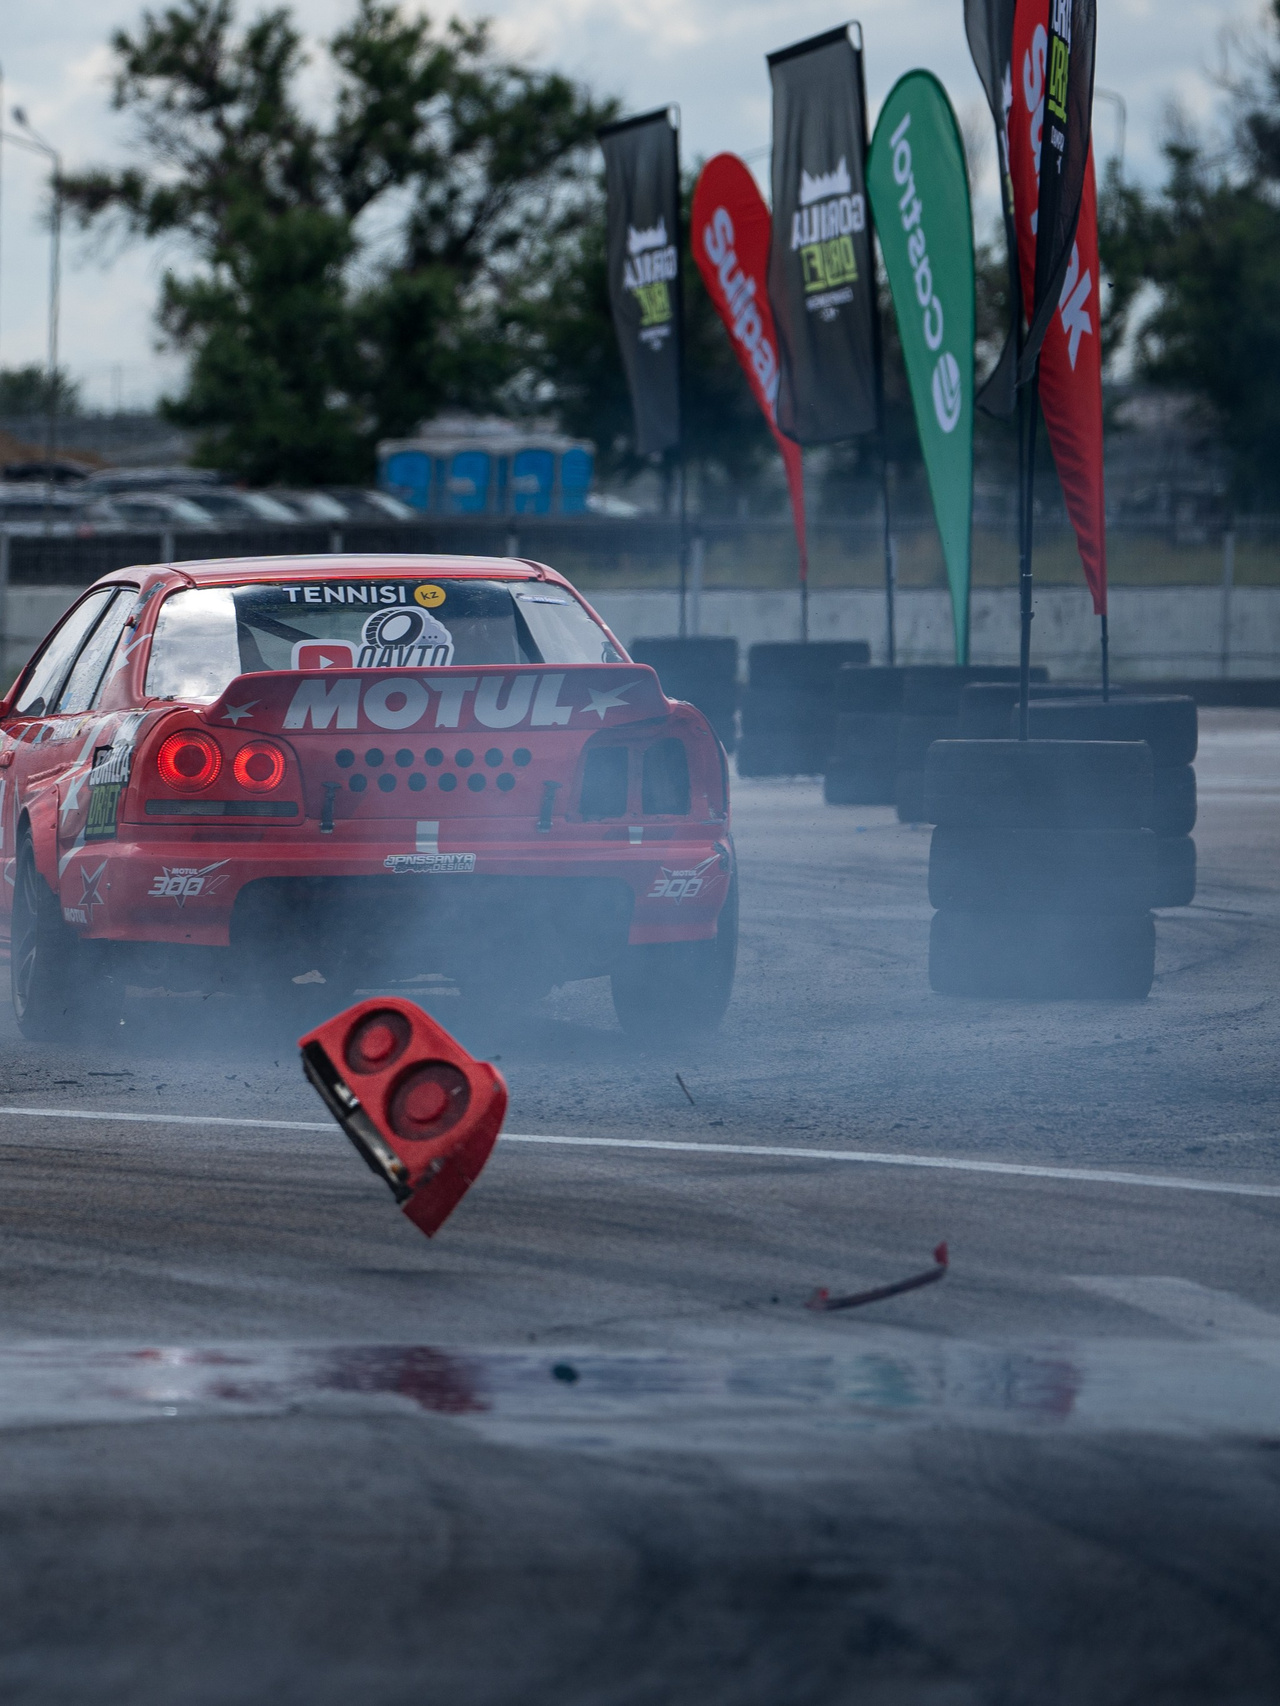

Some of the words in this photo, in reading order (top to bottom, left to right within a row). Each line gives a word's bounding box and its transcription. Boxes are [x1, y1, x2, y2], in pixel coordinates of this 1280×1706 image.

[283, 585, 407, 604] TENNISI
[281, 673, 573, 730] MOTUL
[171, 867, 199, 875] MOTUL
[432, 862, 474, 871] DESIGN
[63, 907, 88, 924] MOTUL
